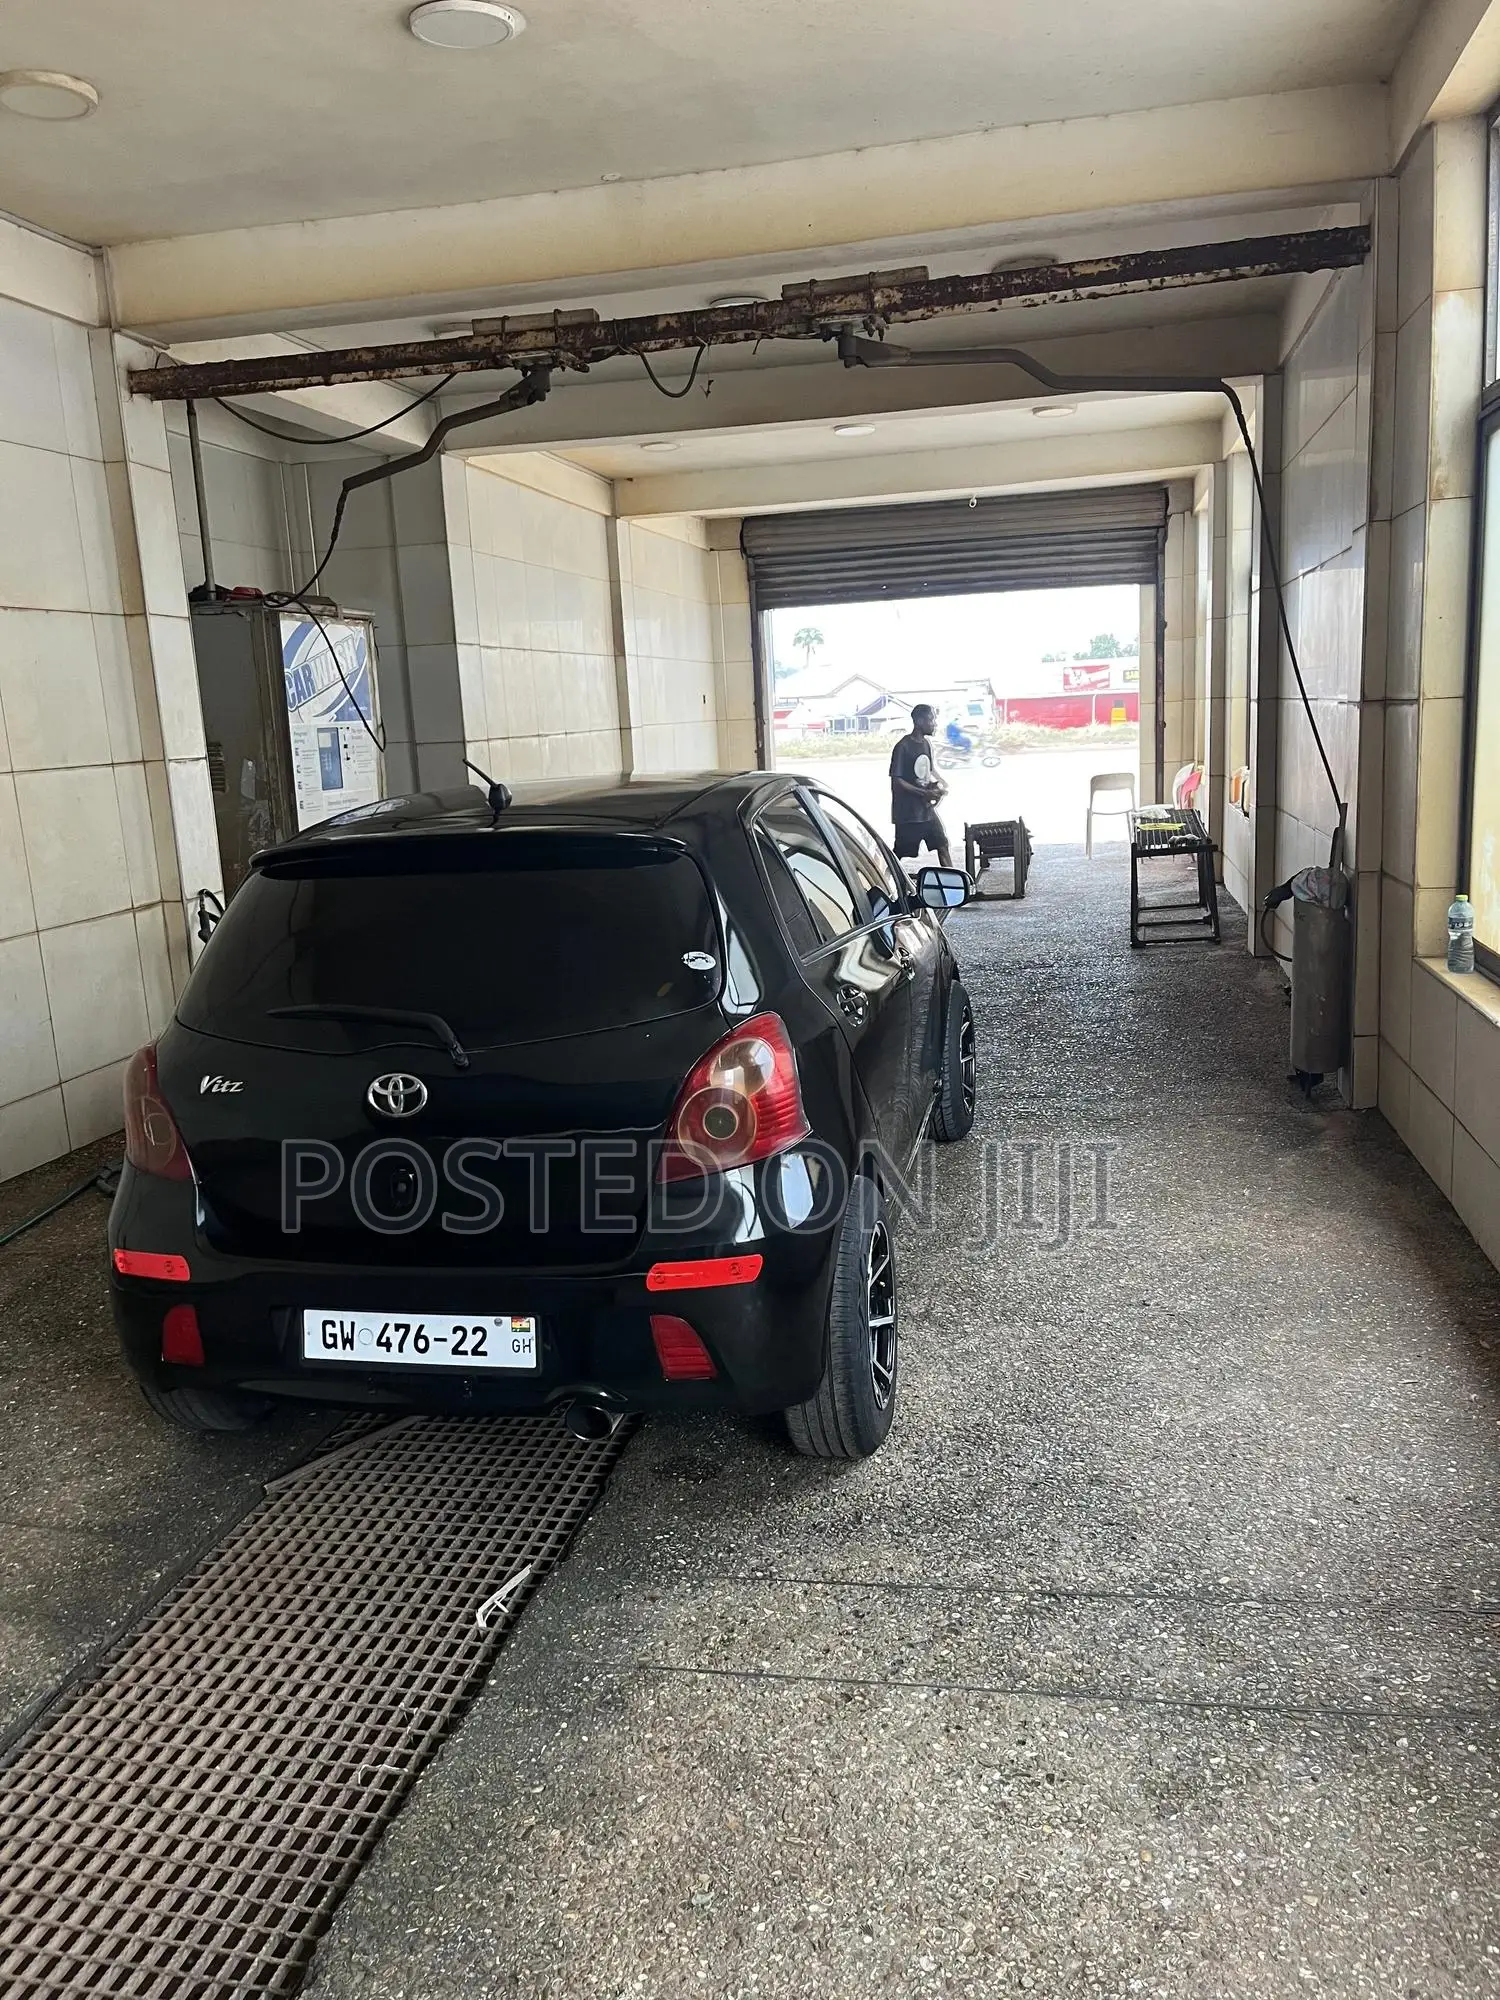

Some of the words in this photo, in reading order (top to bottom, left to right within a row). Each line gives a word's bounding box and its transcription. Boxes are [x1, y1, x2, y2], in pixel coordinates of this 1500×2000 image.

[285, 662, 317, 709] CAR
[200, 1075, 244, 1095] Vitz
[321, 1319, 355, 1351] GW
[376, 1322, 488, 1357] 476-22
[511, 1338, 532, 1353] GH
